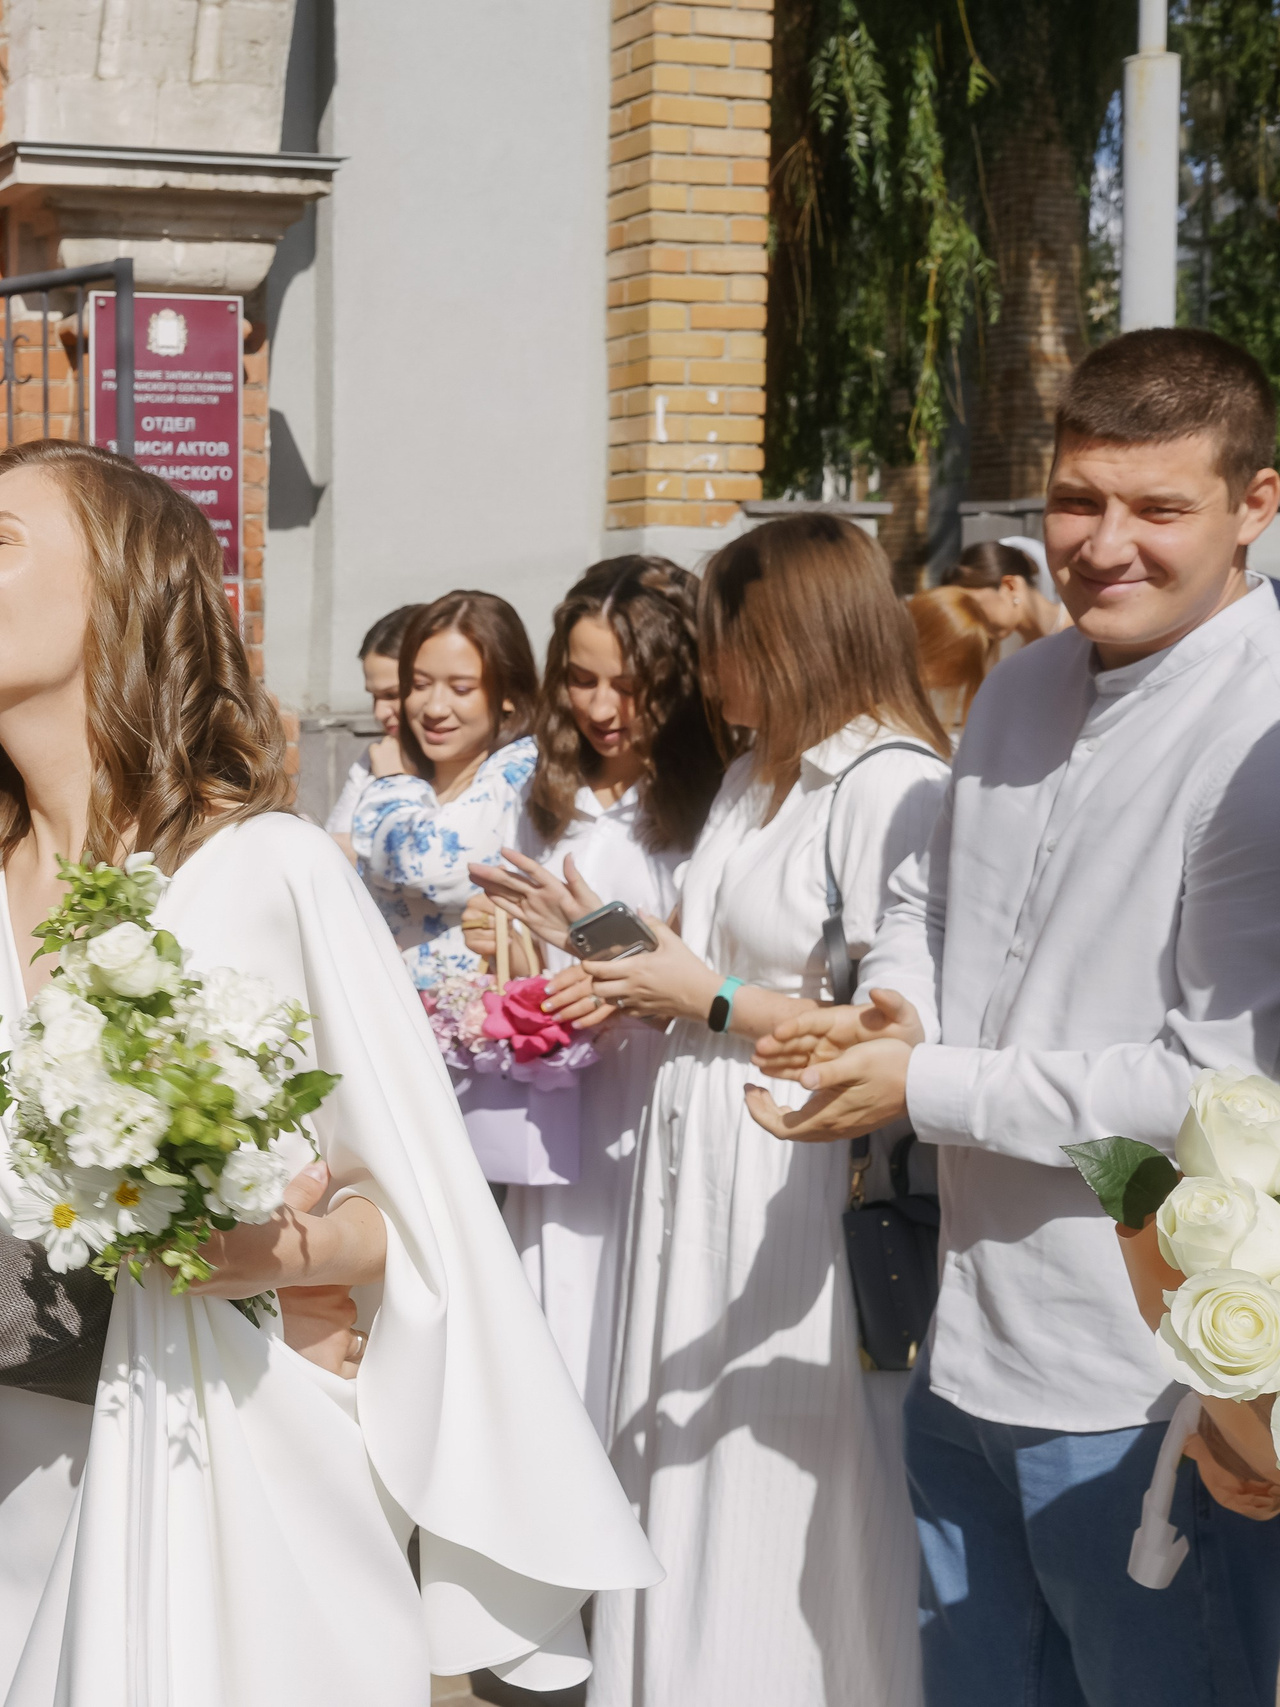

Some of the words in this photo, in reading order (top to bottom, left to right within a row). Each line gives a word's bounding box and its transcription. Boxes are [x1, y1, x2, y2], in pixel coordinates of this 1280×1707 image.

[165, 370, 201, 381] ЗАПИСИ
[202, 371, 233, 382] АКТОВ
[177, 382, 234, 393] СОСТОЯНИЯ
[175, 394, 220, 405] ОБЛАСТИ
[141, 416, 196, 433] ОТДЕЛ
[106, 440, 174, 456] ЗИСИ
[175, 441, 230, 457] АКТОВ
